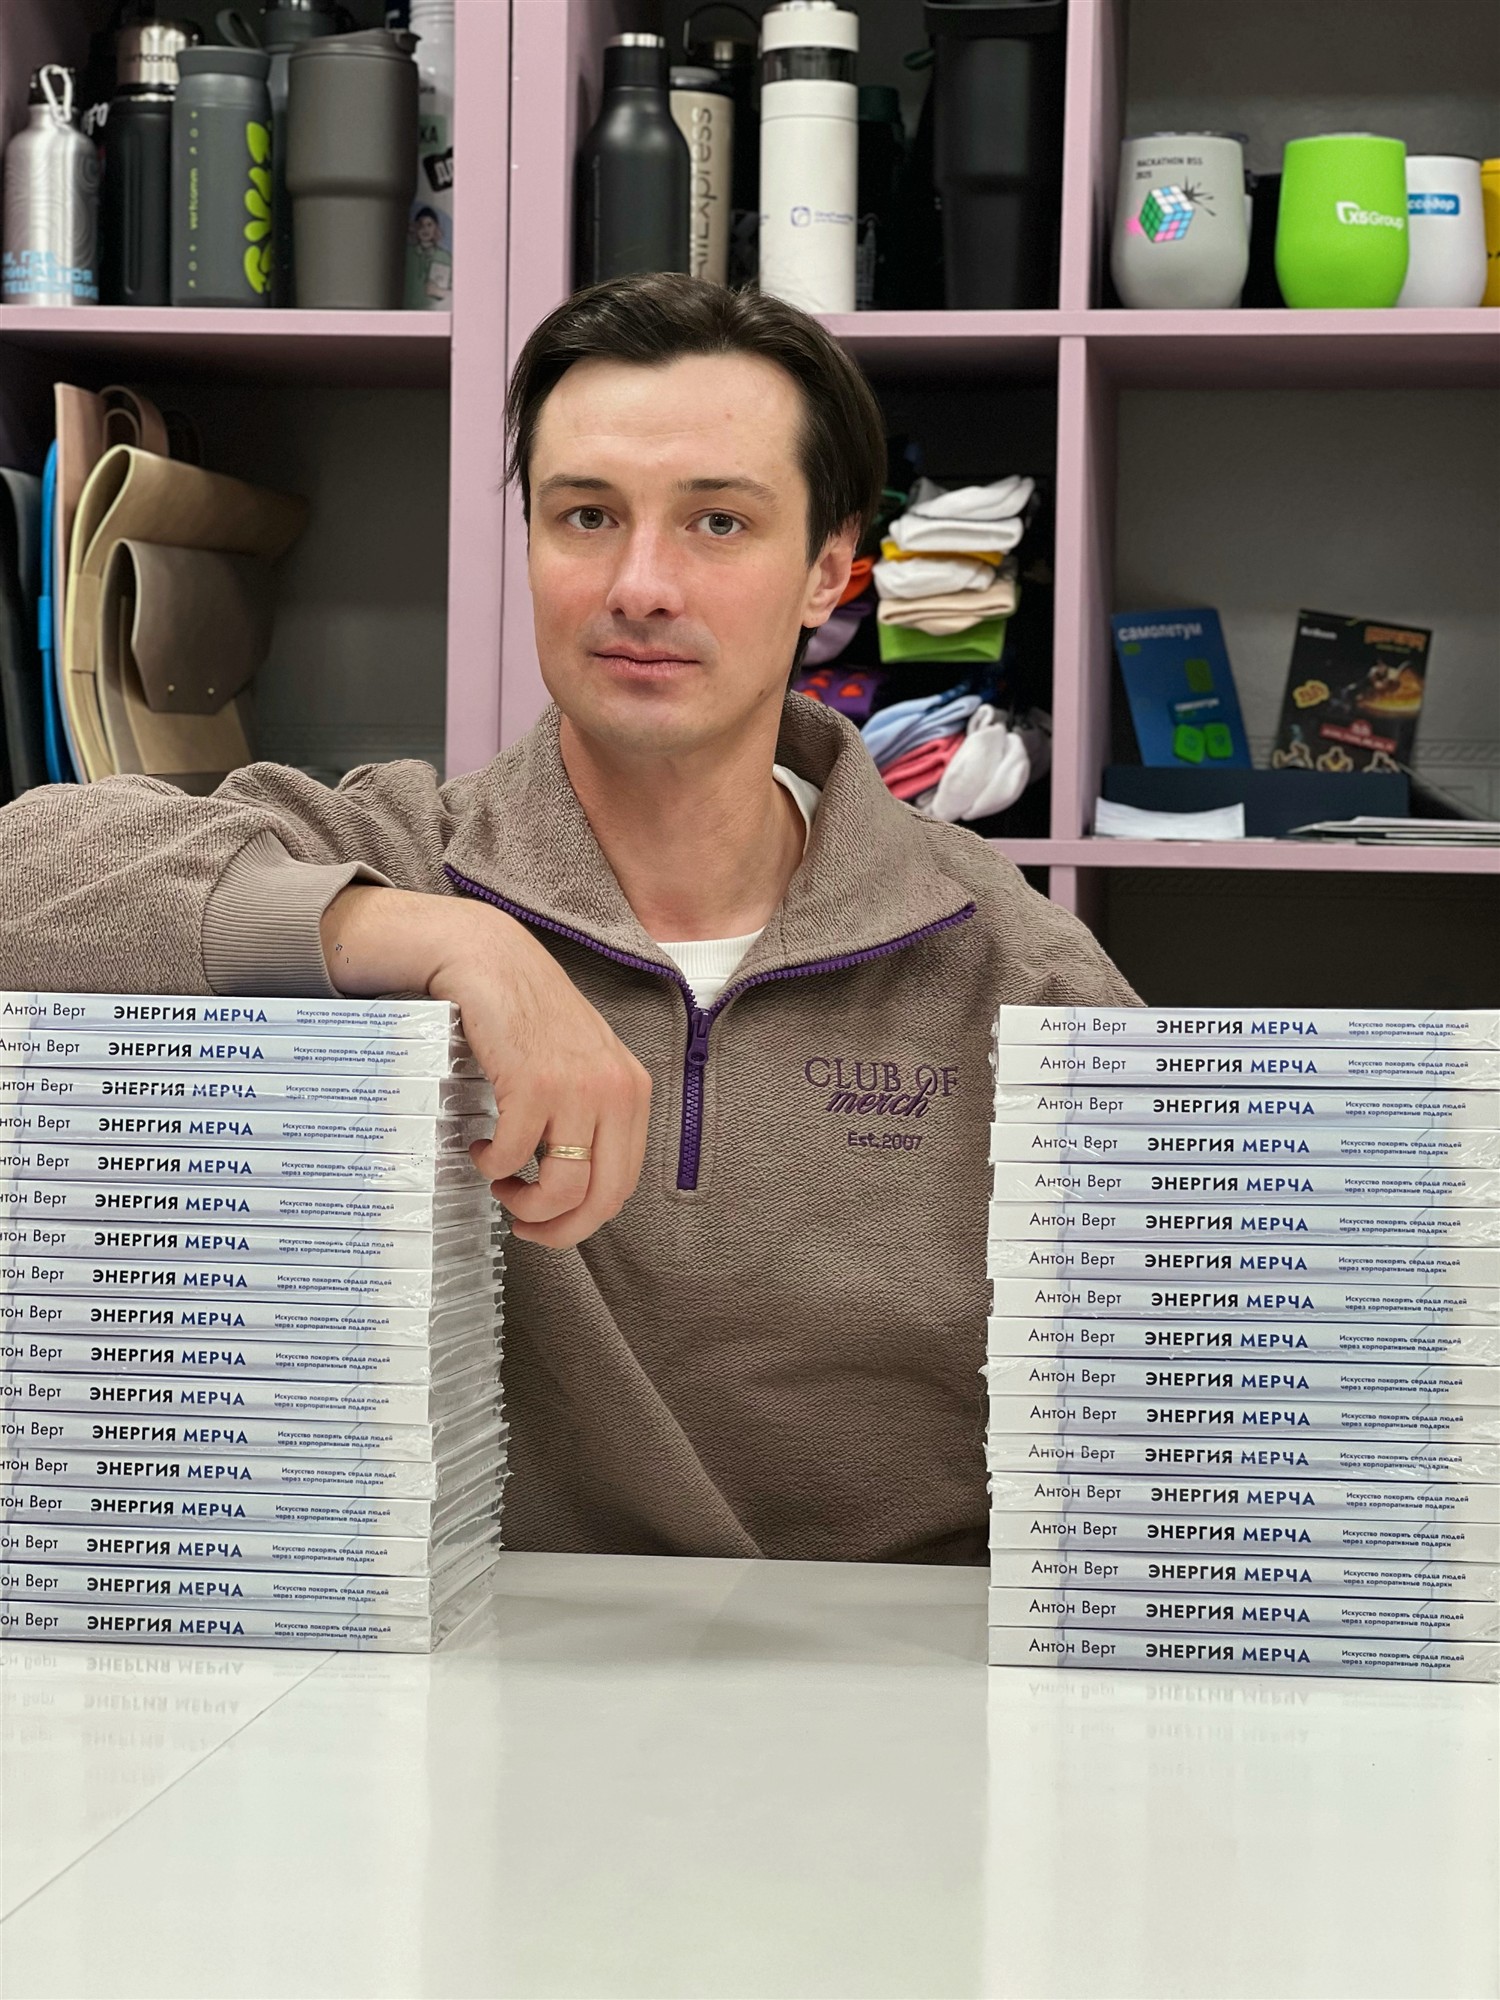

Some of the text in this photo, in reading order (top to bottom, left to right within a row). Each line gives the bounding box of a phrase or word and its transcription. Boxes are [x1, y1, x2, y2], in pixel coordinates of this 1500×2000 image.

[4, 1003, 269, 1022] Антон Верт ЭНЕРГИЯ МЕРЧА
[1040, 1018, 1318, 1037] Антон Верт ЭНЕРГИЯ МЕРЧА
[47, 1039, 80, 1057] Верт
[109, 1041, 192, 1057] ЭНЕРГИЯ
[200, 1044, 265, 1059] МЕРЧА
[293, 1046, 327, 1054] Искусство
[1040, 1056, 1318, 1075] Антон Верт ЭНЕРГИЯ МЕРЧА
[1348, 1060, 1382, 1068] Искусство
[804, 1056, 959, 1097] CLUB OF
[0, 1078, 257, 1098] нтон Верт ЭНЕРГИЯ МЕРЧА
[825, 1077, 932, 1119] merch
[1037, 1096, 1315, 1116] Антон Верт ЭНЕРГИЯ МЕРЧА
[38, 1115, 71, 1133] Верт
[99, 1117, 182, 1133] ЭНЕРГИЯ
[189, 1120, 254, 1135] МЕРЧА
[37, 1154, 70, 1172] Верт
[98, 1156, 181, 1172] ЭНЕРГИЯ
[188, 1159, 253, 1174] МЕРЧА
[1035, 1174, 1314, 1193] Антон Верт ЭНЕРГИЯ МЕРЧА
[1029, 1213, 1309, 1233] Антон Верт ЭНЕРГИЯ МЕРЧА
[1029, 1251, 1308, 1272] Антон Верт ЭНЕРГИЯ МЕРЧА
[1035, 1290, 1314, 1310] Антон Верт ЭНЕРГИЯ МЕРЧА
[1345, 1296, 1380, 1304] Искусство
[30, 1305, 63, 1323] Верт
[91, 1308, 174, 1324] ЭНЕРГИЯ
[181, 1311, 246, 1326] МЕРЧА
[274, 1314, 308, 1322] Искусство
[30, 1344, 63, 1362] Верт
[91, 1347, 174, 1363] ЭНЕРГИЯ
[182, 1350, 247, 1365] МЕРЧА
[1029, 1369, 1309, 1391] Антон Верт ЭНЕРГИЯ МЕРЧА
[1030, 1406, 1310, 1428] Антон Верт ЭНЕРГИЯ МЕРЧА
[31, 1422, 64, 1440] Верт
[93, 1425, 176, 1441] ЭНЕРГИЯ
[184, 1428, 249, 1443] МЕРЧА
[1034, 1484, 1315, 1507] Антон Верт ЭНЕРГИЯ МЕРЧА
[30, 1495, 63, 1513] Верт
[91, 1498, 174, 1514] ЭНЕРГИЯ
[182, 1502, 247, 1517] МЕРЧА
[1030, 1521, 1311, 1545] Антон Верт ЭНЕРГИЯ МЕРЧА
[1342, 1530, 1377, 1538] Искусство
[1032, 1561, 1312, 1584] Антон Верт ЭНЕРГИЯ МЕРЧА
[26, 1574, 59, 1592] Верт
[88, 1577, 171, 1593] ЭНЕРГИЯ
[179, 1581, 244, 1596] МЕРЧА
[26, 1613, 59, 1631] Верт
[88, 1615, 171, 1631] ЭНЕРГИЯ
[180, 1619, 245, 1634] МЕРЧА
[1029, 1639, 1310, 1664] Антон Верт ЭНЕРГИЯ МЕРЧА
